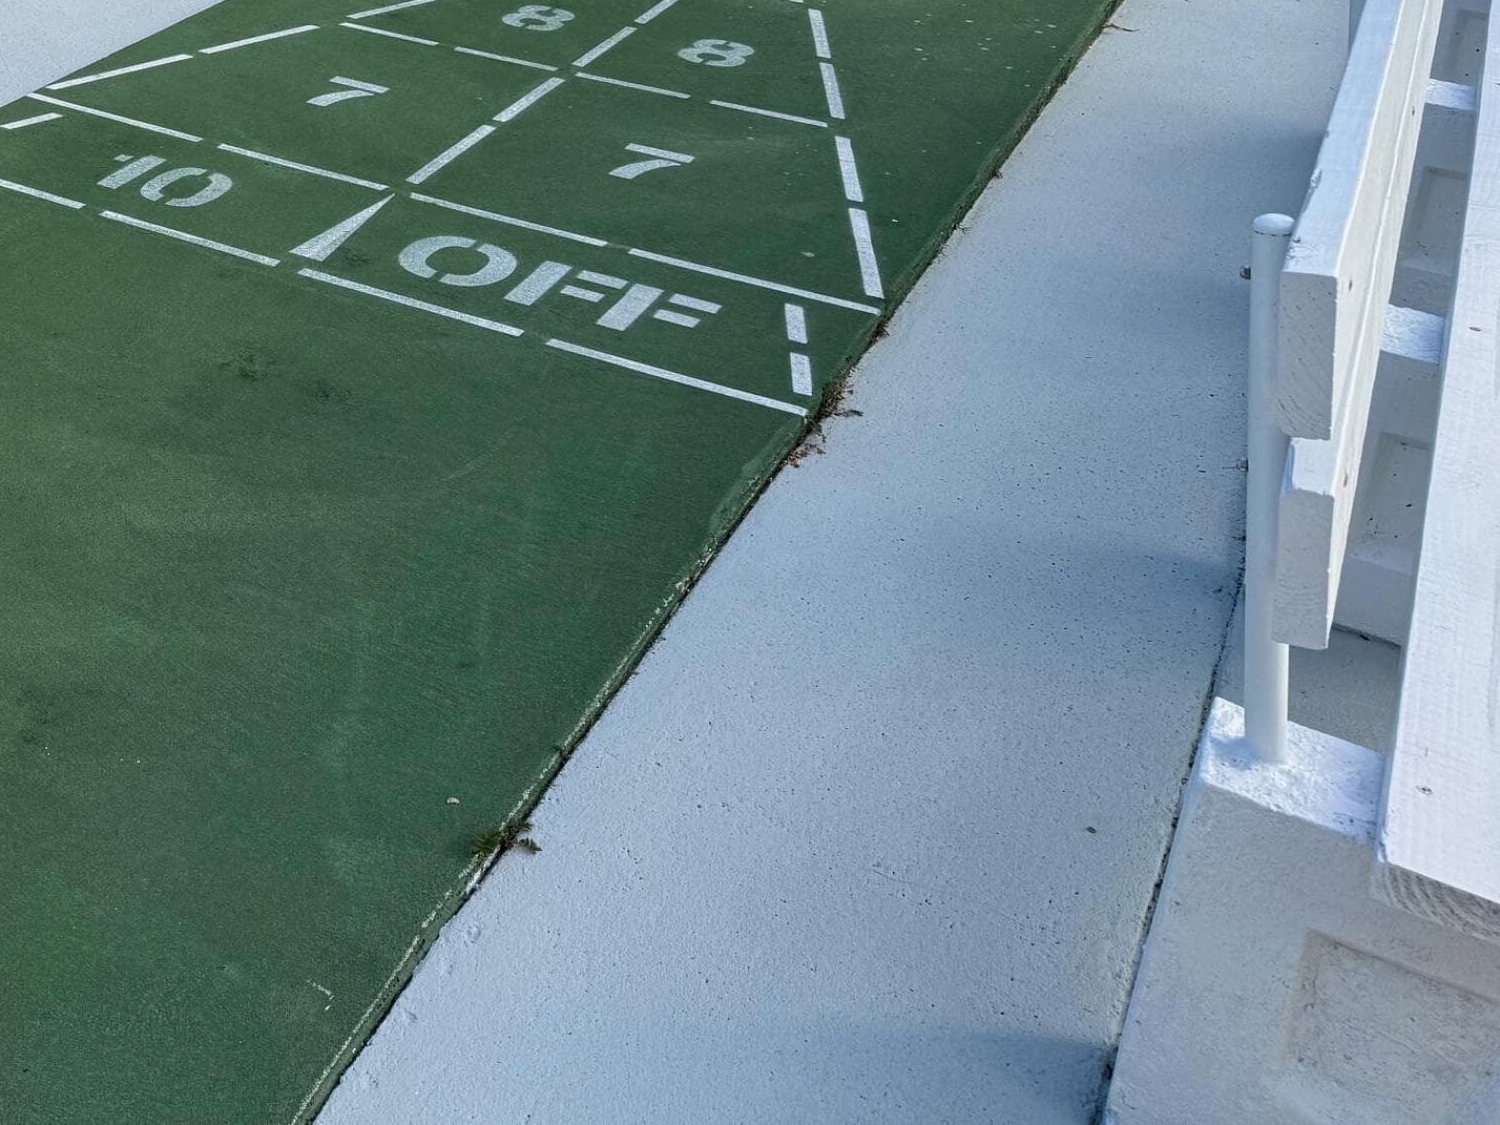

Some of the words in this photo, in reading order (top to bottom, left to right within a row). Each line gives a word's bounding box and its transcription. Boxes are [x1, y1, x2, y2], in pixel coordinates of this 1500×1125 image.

[502, 5, 574, 30] 8
[678, 39, 754, 66] 8
[307, 76, 389, 106] 7
[609, 143, 694, 179] 7
[97, 155, 232, 206] 10
[399, 236, 721, 331] OFF
